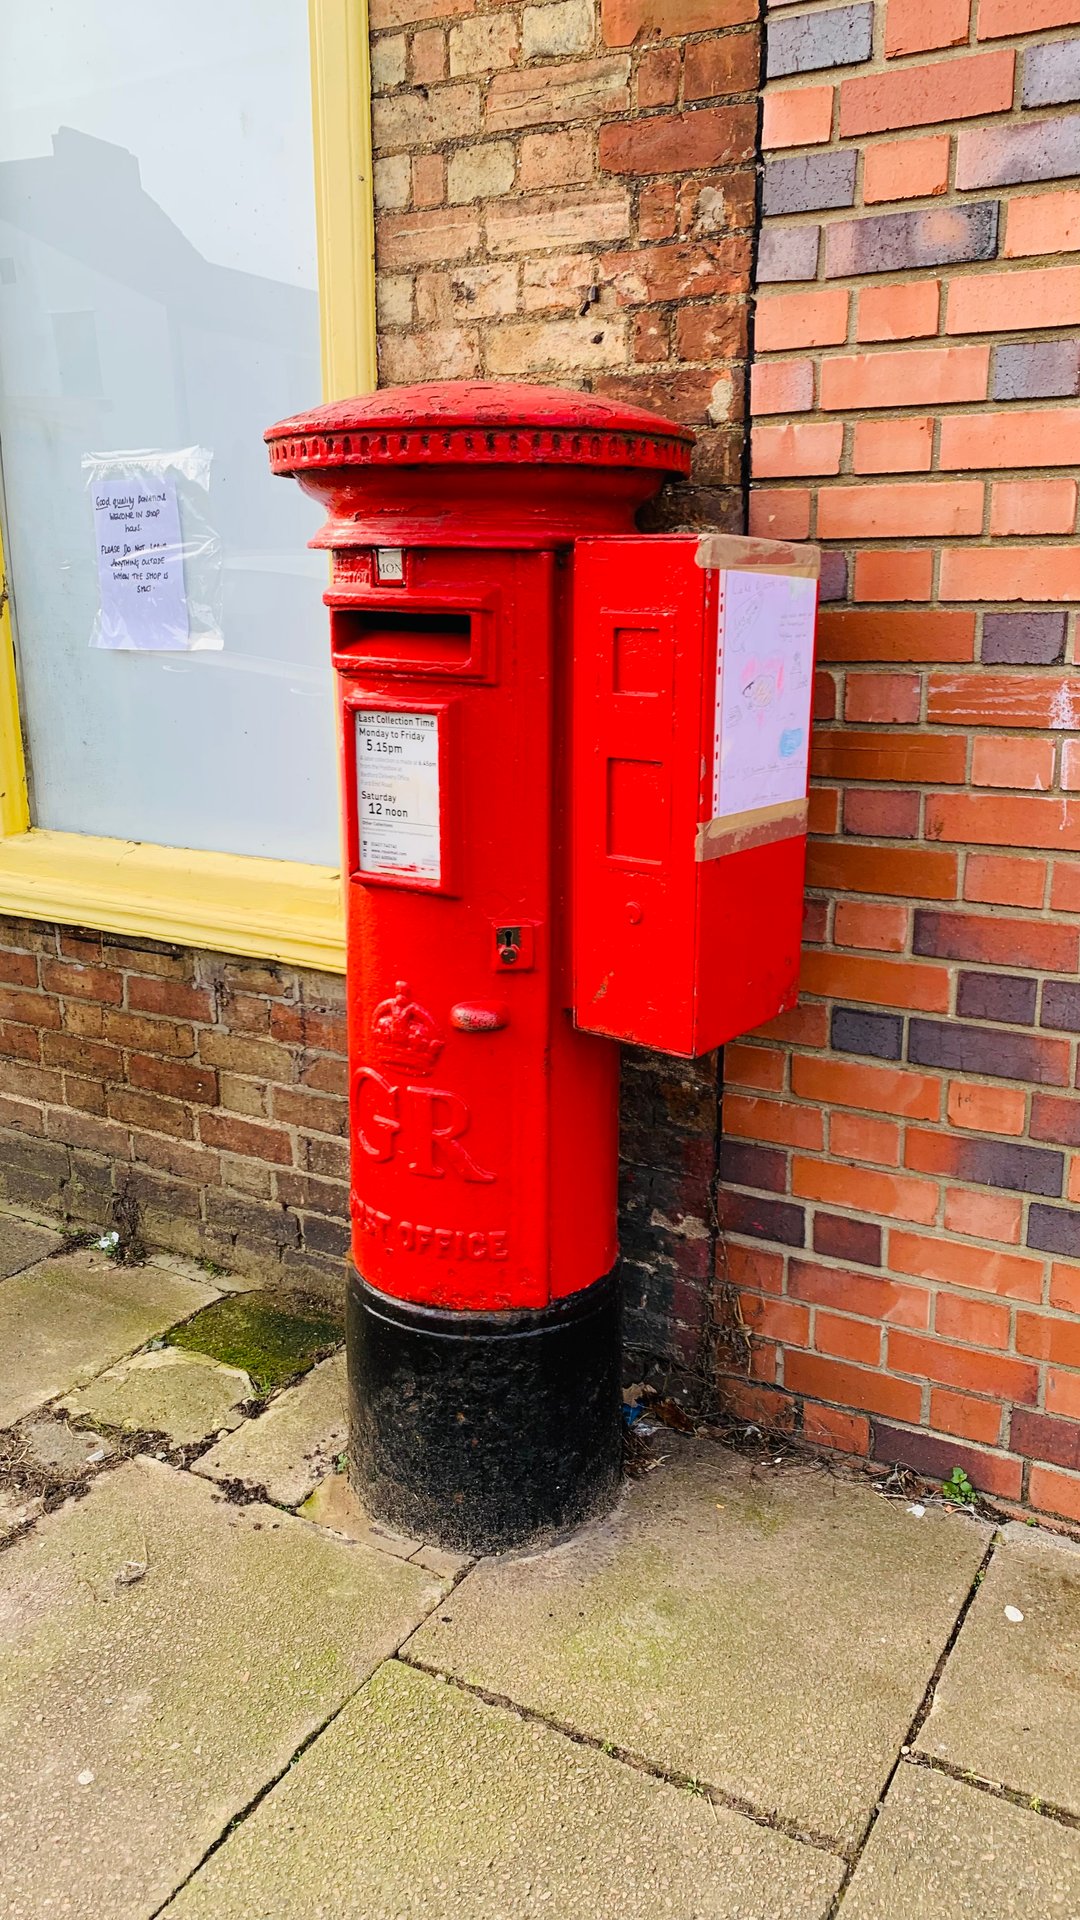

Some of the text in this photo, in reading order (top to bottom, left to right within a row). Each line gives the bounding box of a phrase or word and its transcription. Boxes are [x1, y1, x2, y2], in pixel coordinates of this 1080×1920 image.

[96, 496, 110, 508] Good
[113, 495, 134, 510] quality
[145, 509, 160, 518] SHOP
[101, 545, 120, 555] PLEASE
[124, 544, 131, 556] DO
[110, 558, 139, 570] ANYTHING
[131, 572, 142, 580] THE
[145, 572, 161, 580] SHOP
[359, 714, 434, 727] Last Collection Time
[360, 728, 389, 739] Monday
[401, 730, 425, 742] Friday
[366, 739, 402, 754] 5.15pm
[361, 790, 396, 803] Saturday
[368, 803, 408, 817] 12 noon
[354, 1066, 498, 1182] GR
[399, 1220, 508, 1261] OFFICE
